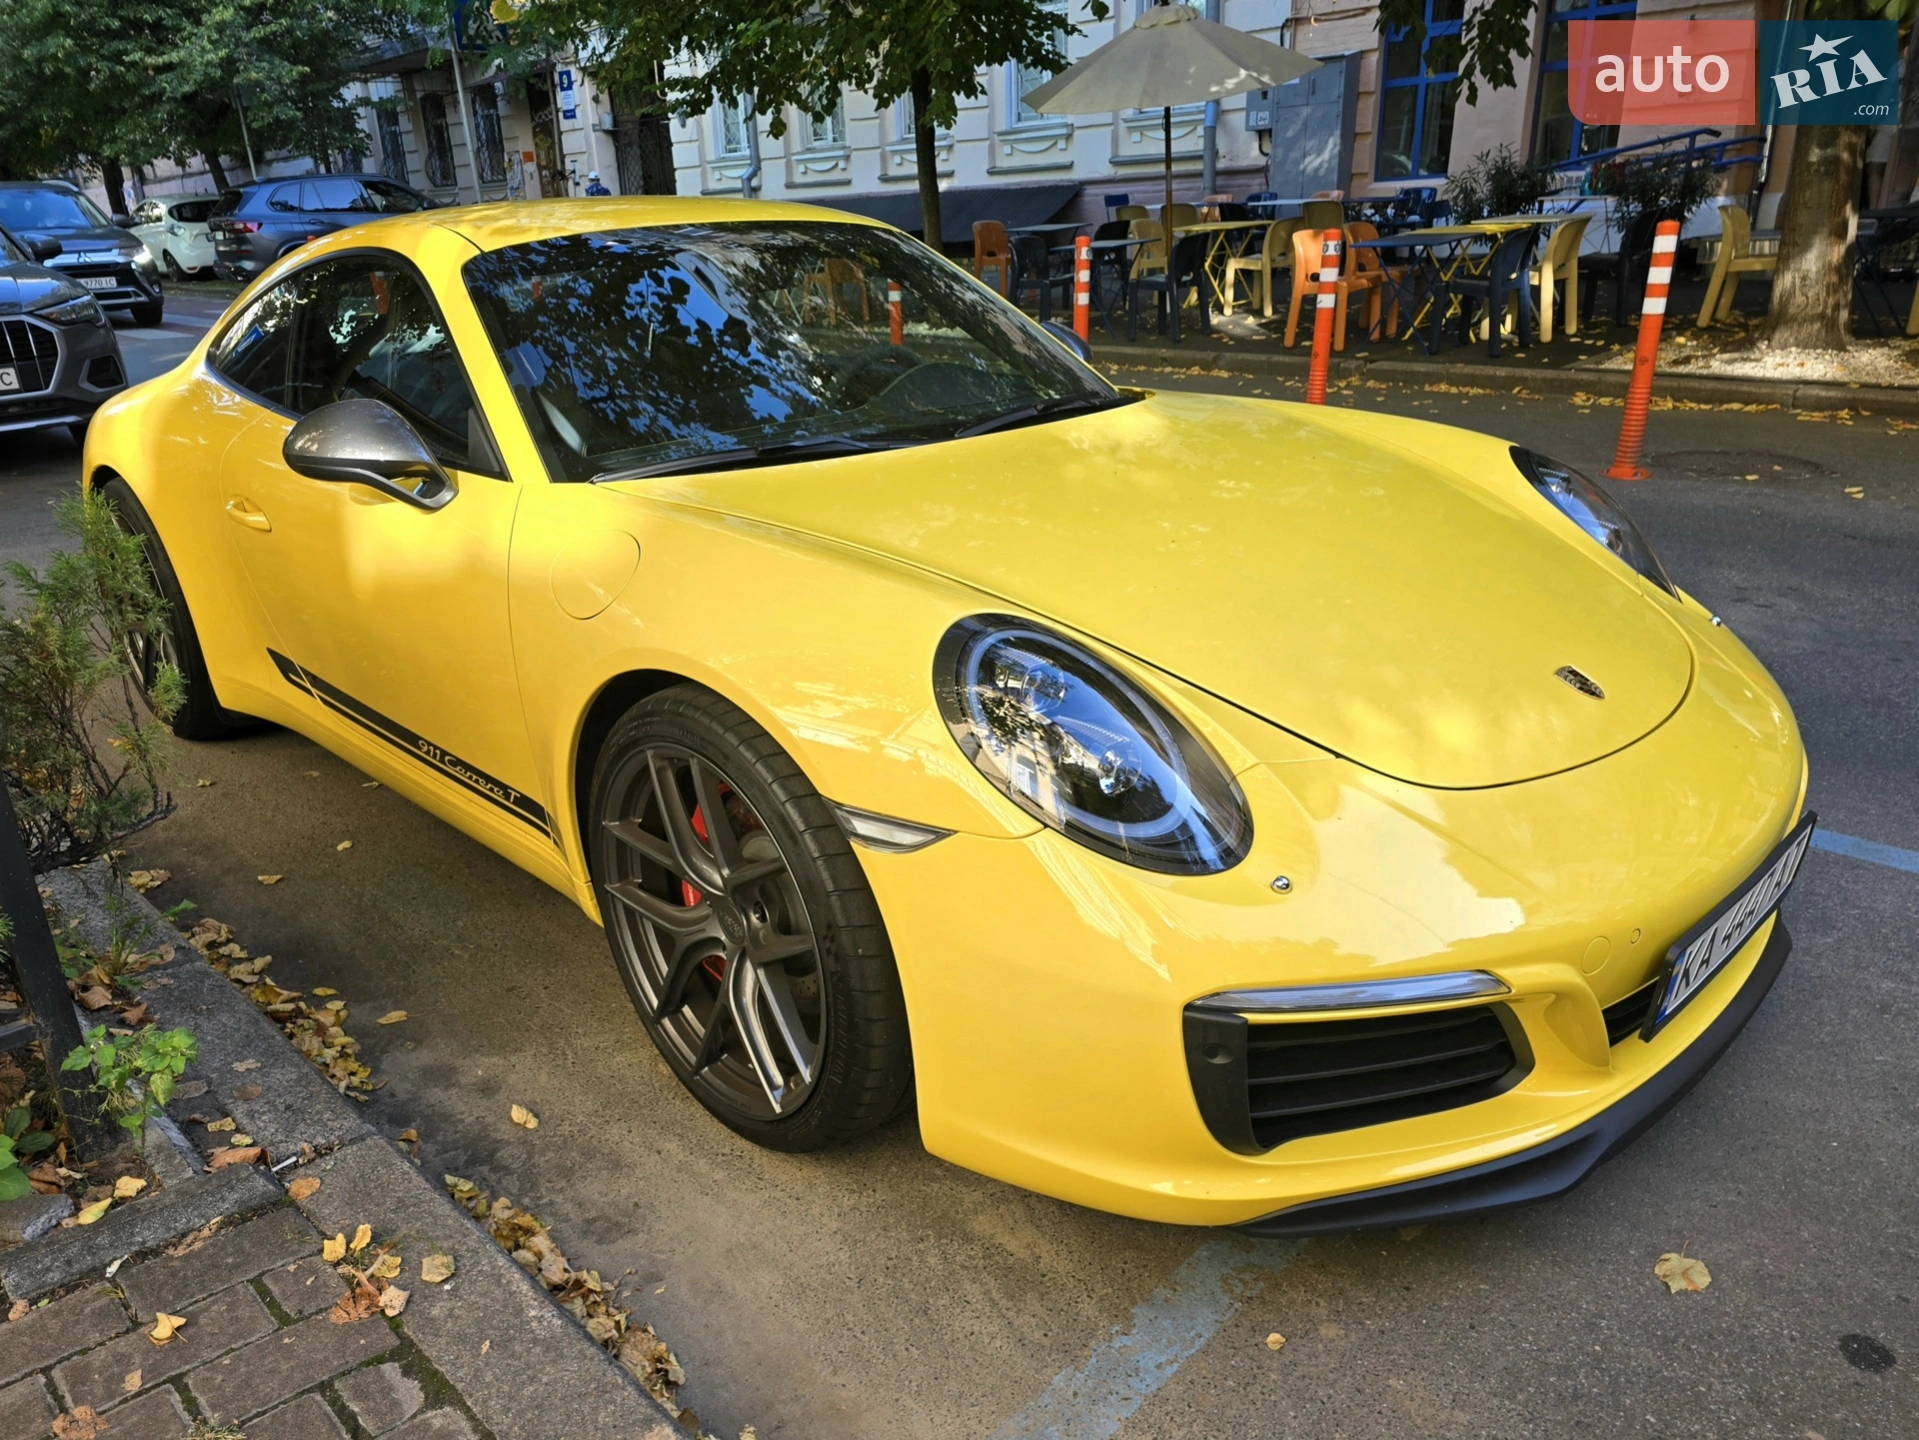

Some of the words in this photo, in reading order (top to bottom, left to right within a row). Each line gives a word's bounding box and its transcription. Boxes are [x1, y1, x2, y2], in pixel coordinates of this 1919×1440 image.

[562, 74, 568, 88] 9
[418, 739, 441, 761] 911
[444, 755, 506, 799] Carrera
[507, 788, 521, 803] T
[1674, 925, 1719, 1001] KA
[1720, 865, 1777, 951] 4447
